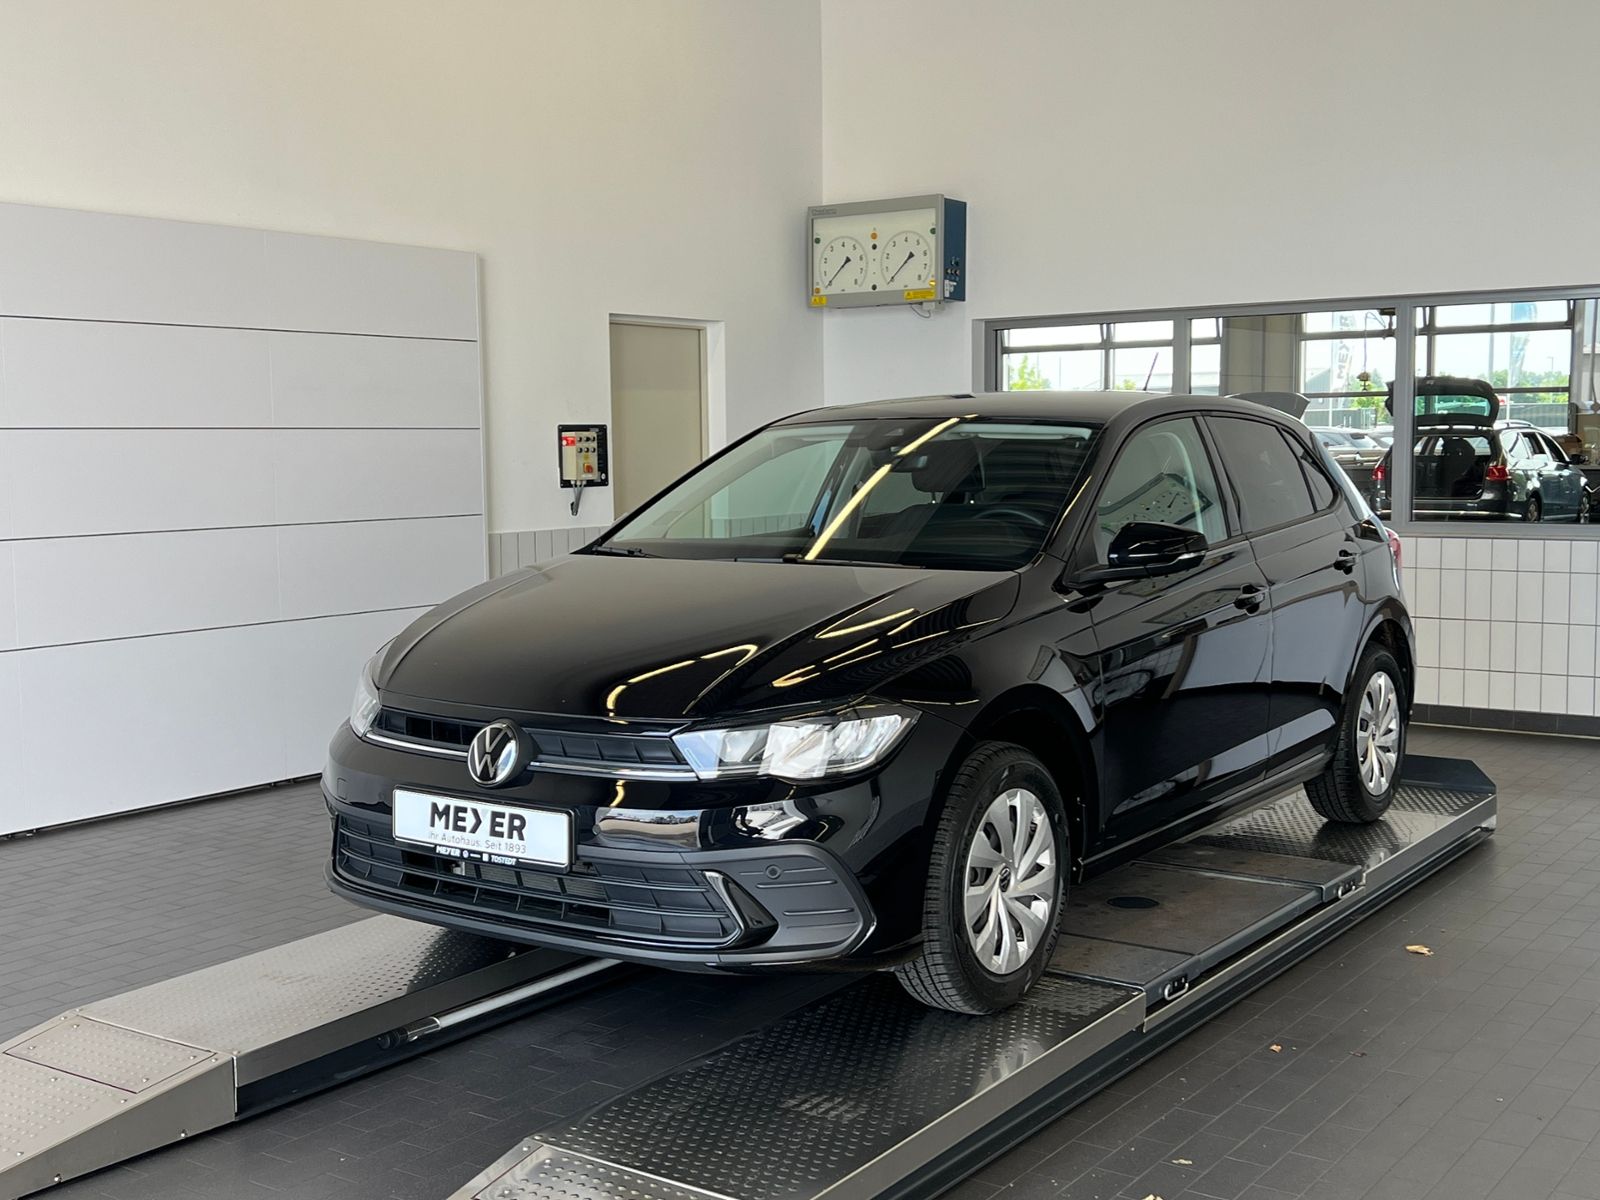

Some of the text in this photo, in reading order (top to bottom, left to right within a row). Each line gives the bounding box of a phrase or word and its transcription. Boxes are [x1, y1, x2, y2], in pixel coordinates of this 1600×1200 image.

[1337, 316, 1350, 379] MEYR
[485, 839, 501, 850] Seit
[505, 843, 526, 854] 1893
